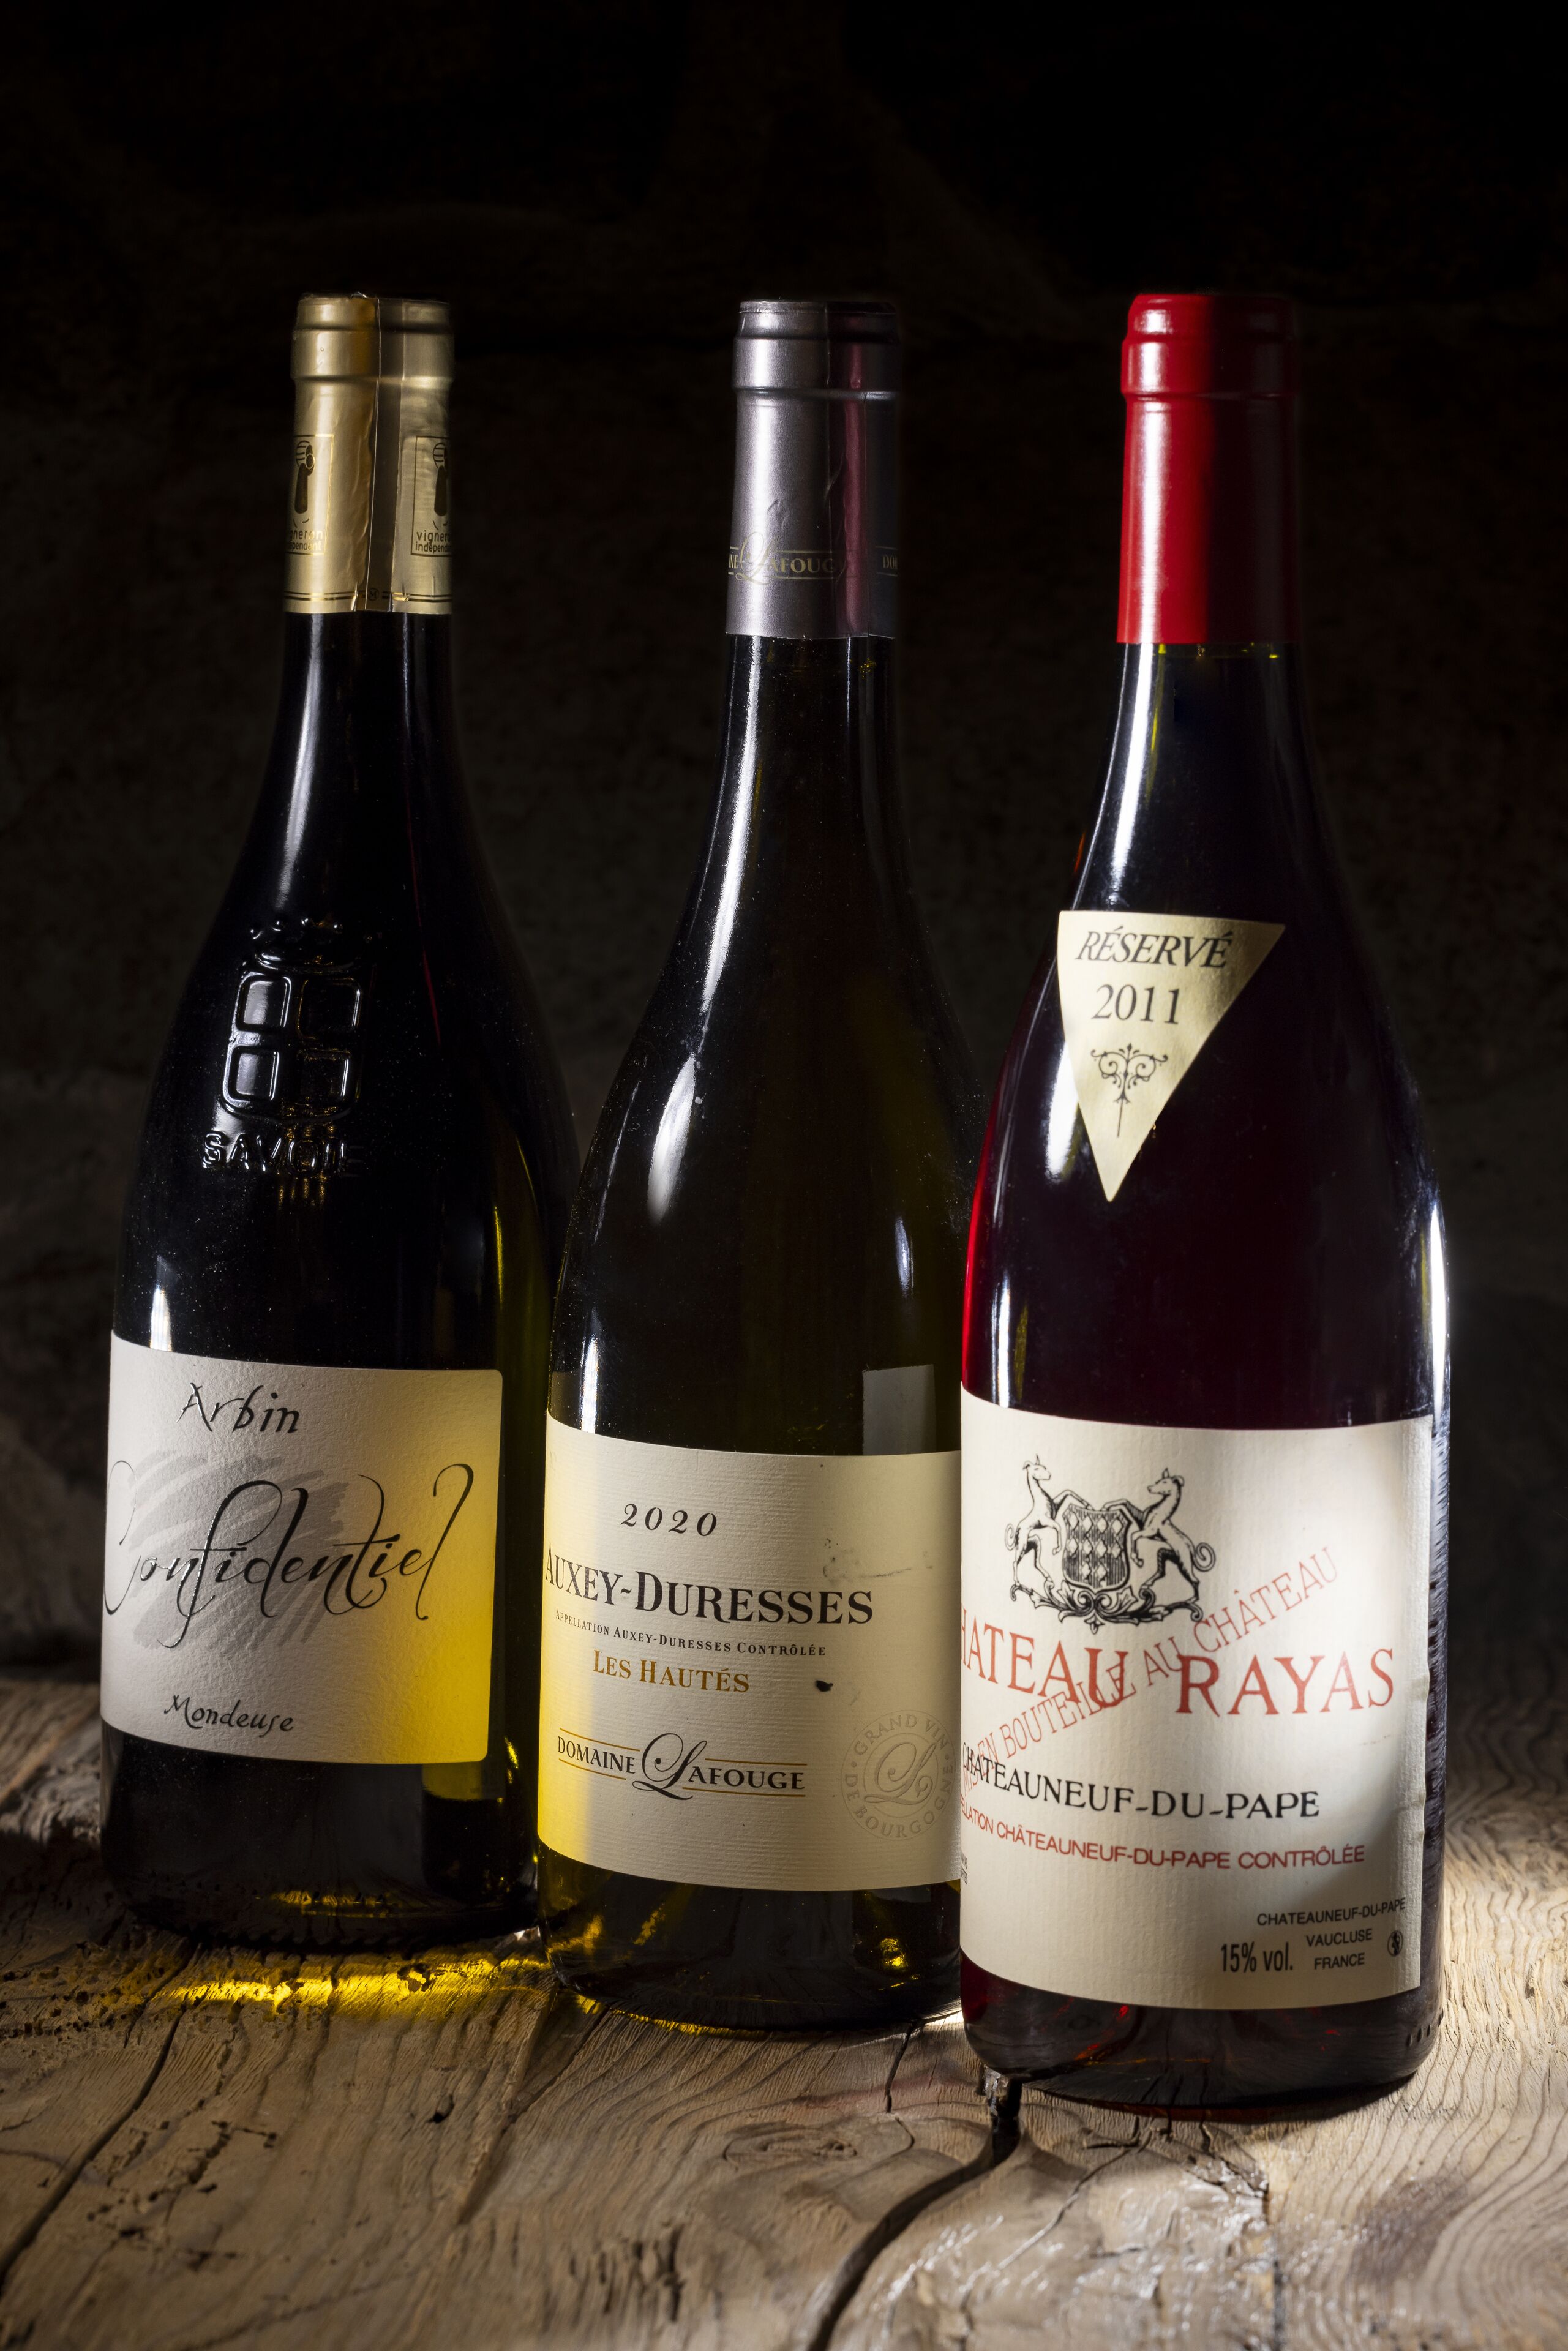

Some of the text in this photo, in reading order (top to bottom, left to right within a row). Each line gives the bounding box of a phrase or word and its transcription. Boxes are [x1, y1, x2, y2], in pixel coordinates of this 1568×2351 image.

[1075, 925, 1234, 968] RÉSERVÉ
[1090, 984, 1180, 1025] 2011
[203, 1132, 367, 1177] SAVOIE
[176, 1382, 301, 1434] Arbin
[620, 1502, 717, 1537] 2020
[104, 1460, 475, 1649] Confidentiel
[545, 1542, 874, 1625] AUXEY-DURESSES
[555, 1609, 827, 1657] APPELLATION AUXEY-DURESSES CONTRÔLÉE
[592, 1649, 750, 1693] LES HAUTÉS
[977, 1732, 999, 1777] EN
[999, 1663, 1137, 1759] BOUTEILLE
[1142, 1636, 1185, 1686] AU
[1193, 1547, 1338, 1653] CHÂTEAU
[1175, 1648, 1395, 1717] RAYAS
[557, 1735, 636, 1775] DOMAINE
[854, 1714, 950, 1756] GRAND VIN
[962, 1742, 1321, 1820] CHATEAUNEUF-DU-PAPE
[996, 1821, 1231, 1869] CHÂTEAUNEUF-DU-PAPE
[1239, 1843, 1365, 1869] CONTRÔLÉE
[1256, 1897, 1406, 1926] CHATEAUNEUF-DU-PAPE
[1220, 1941, 1294, 1973] 15% vol.
[1305, 1928, 1373, 1948] VAUCLUSE
[1314, 1952, 1365, 1970] FRANCE
